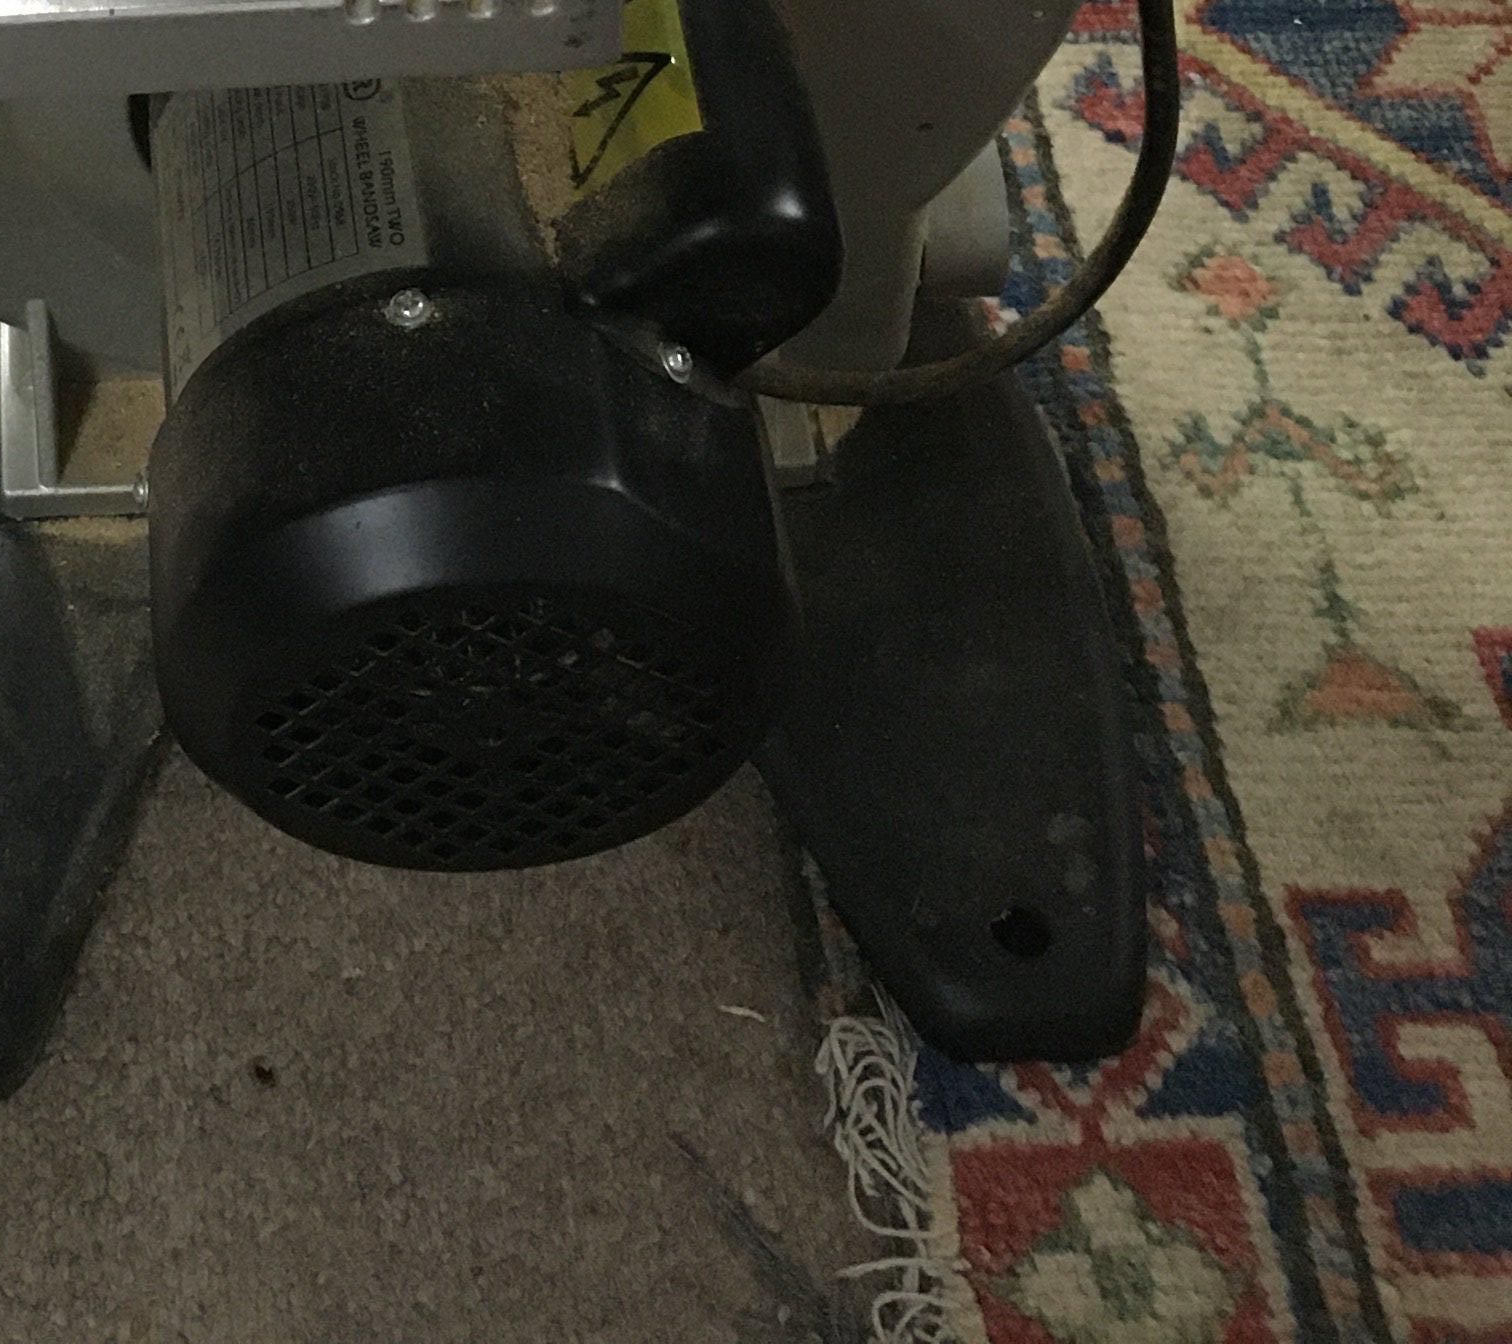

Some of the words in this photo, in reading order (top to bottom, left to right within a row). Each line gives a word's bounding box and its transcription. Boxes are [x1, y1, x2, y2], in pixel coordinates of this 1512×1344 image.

[352, 115, 370, 169] WHEEL
[359, 170, 382, 249] BANDSAW
[389, 207, 405, 246] TWO
